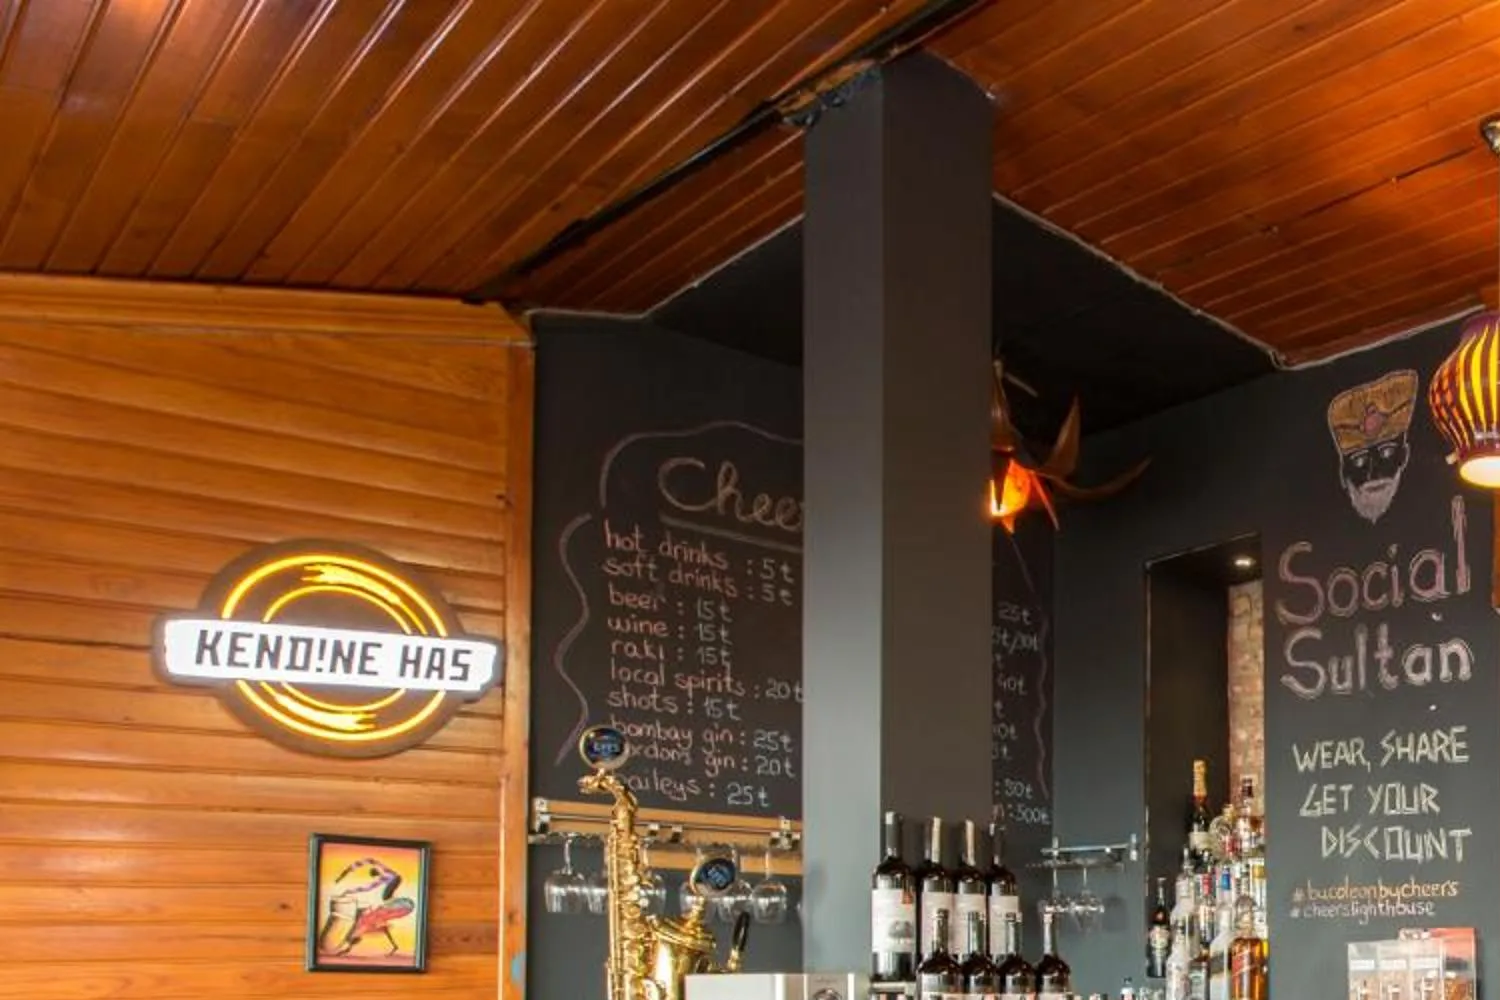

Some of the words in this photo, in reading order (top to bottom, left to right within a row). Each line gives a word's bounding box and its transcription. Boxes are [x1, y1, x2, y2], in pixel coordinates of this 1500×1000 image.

[658, 456, 803, 532] Chee
[604, 519, 643, 551] hot
[659, 530, 728, 570] drinks
[1276, 495, 1471, 627] Social
[602, 550, 661, 582] soft
[668, 563, 738, 598] drinks
[607, 581, 660, 611] beer
[607, 614, 671, 637] wine
[399, 644, 472, 682] HAS
[611, 639, 665, 660] raki
[1280, 624, 1474, 699] Sultan
[610, 657, 665, 686] local
[673, 665, 746, 698] spirits
[607, 683, 679, 714] shots
[702, 722, 733, 754] gin
[1380, 725, 1470, 768] SHARE
[704, 749, 735, 778] gin
[615, 767, 701, 801] aileys
[1300, 783, 1354, 818] GET
[1367, 781, 1441, 816] YOUR
[1321, 823, 1473, 864] DISCOUNT
